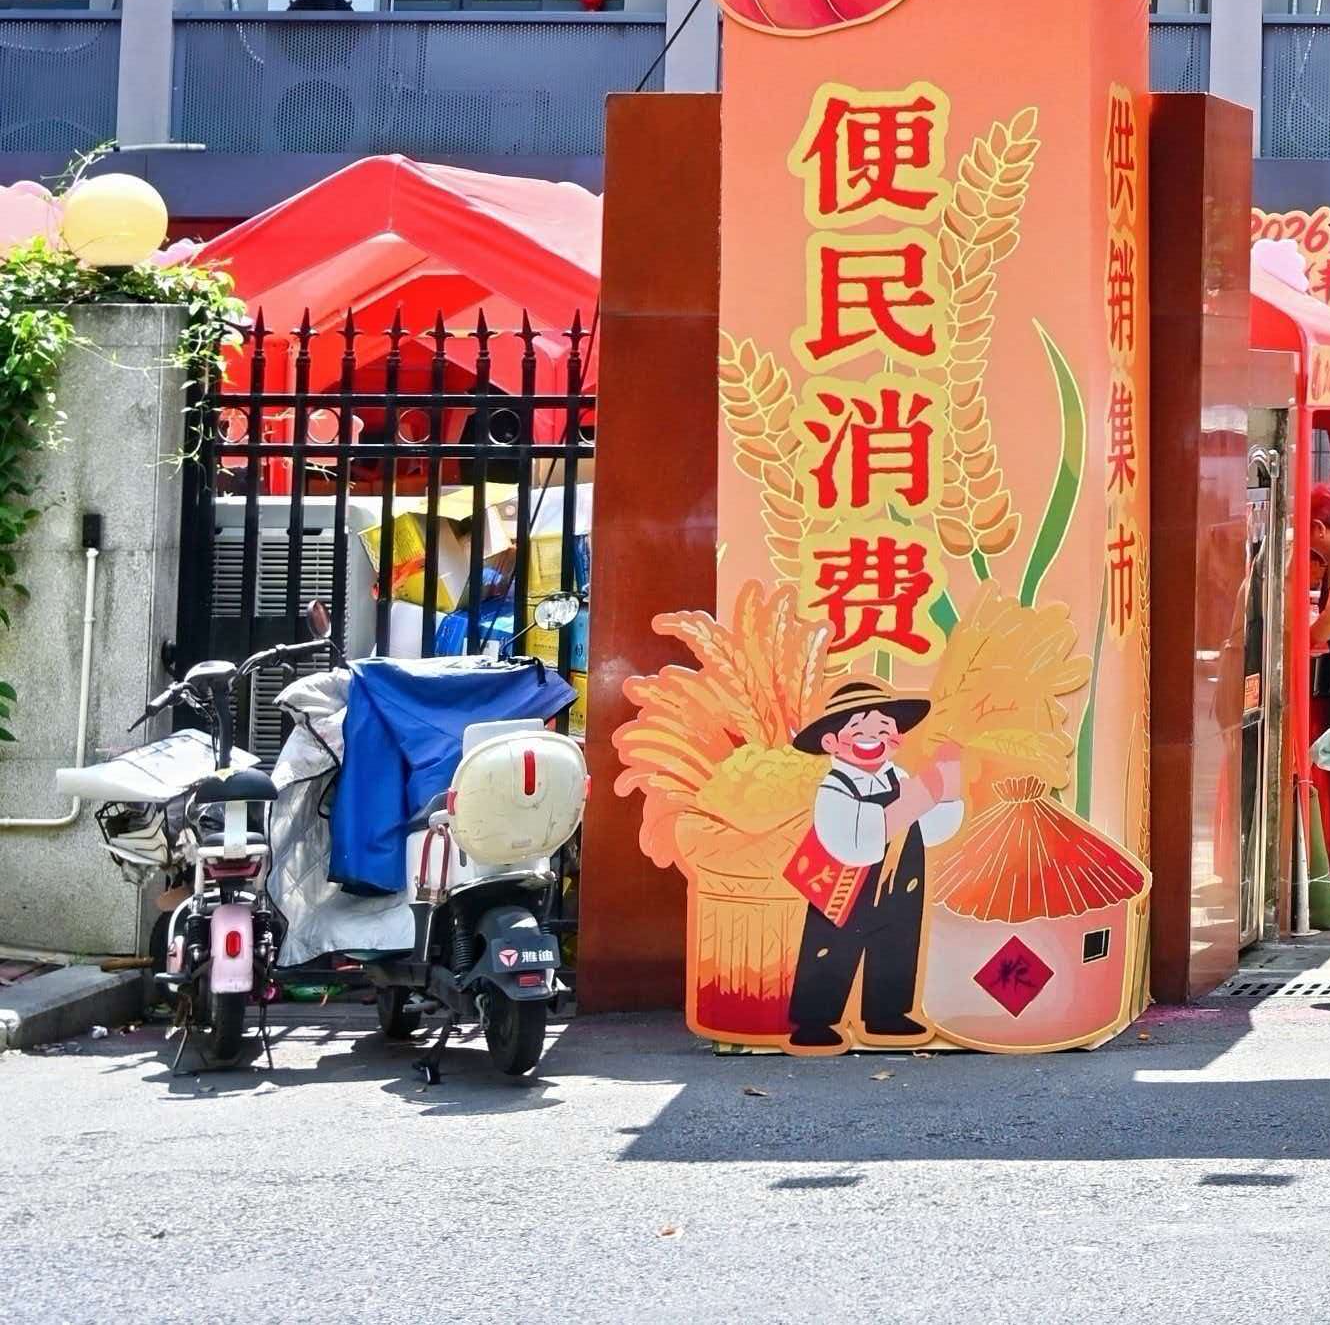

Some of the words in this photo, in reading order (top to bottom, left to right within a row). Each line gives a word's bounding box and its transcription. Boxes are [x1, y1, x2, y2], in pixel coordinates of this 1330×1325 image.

[802, 96, 938, 654] 便民消费
[1105, 96, 1137, 636] 供销集市
